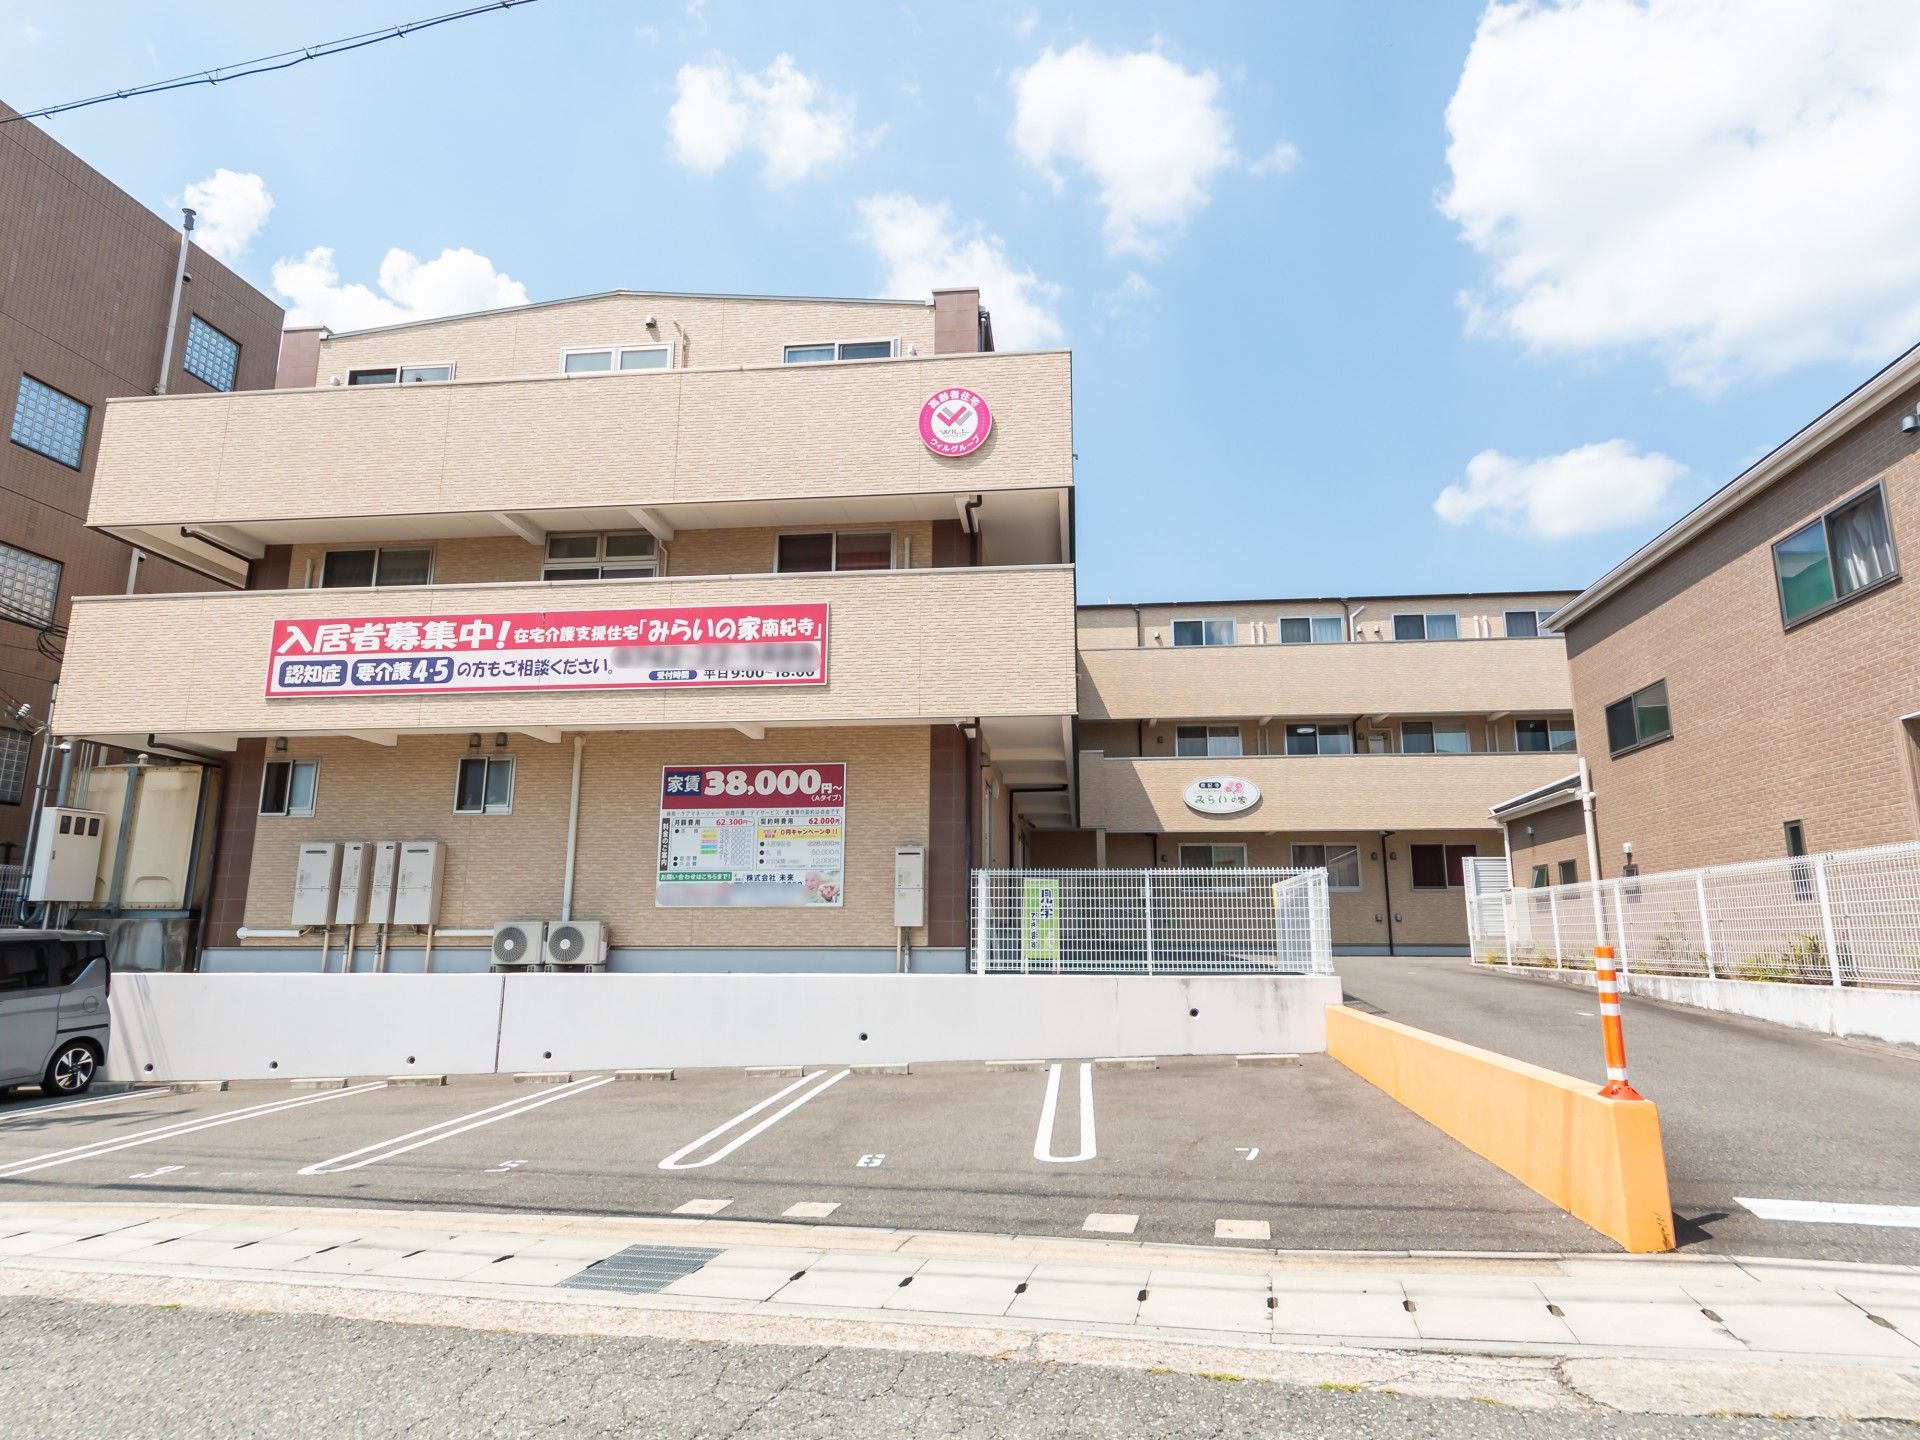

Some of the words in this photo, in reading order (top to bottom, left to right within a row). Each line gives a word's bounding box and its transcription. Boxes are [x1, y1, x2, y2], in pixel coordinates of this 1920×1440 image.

[277, 619, 512, 653] 入居者募集中!
[284, 664, 341, 685] 認知症
[457, 657, 613, 678] の方もご相談ください。
[667, 775, 701, 793] 家賃
[746, 874, 776, 882] 株式会社
[1235, 1147, 1260, 1161] 7
